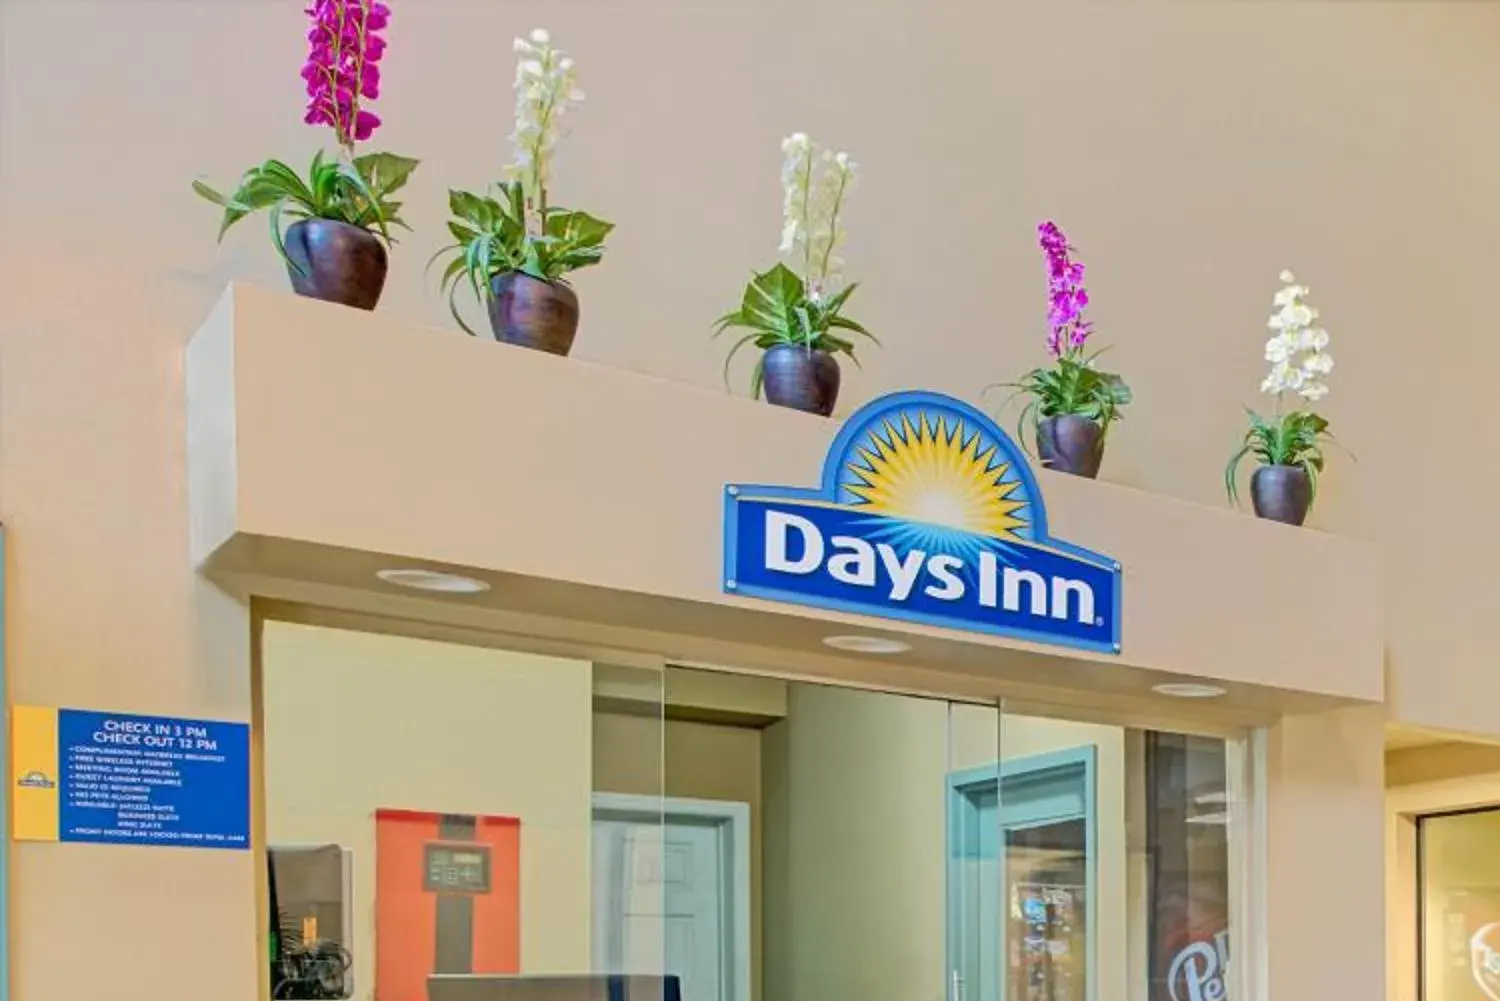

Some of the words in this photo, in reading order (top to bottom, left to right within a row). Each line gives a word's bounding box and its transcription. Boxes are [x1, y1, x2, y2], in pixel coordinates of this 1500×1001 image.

[764, 508, 966, 602] Days
[978, 550, 1096, 626] Inn
[104, 720, 151, 733] CHECK
[155, 724, 169, 735] IN
[186, 727, 206, 737] PM
[93, 732, 139, 745] CHECK
[143, 735, 174, 747] OUT
[179, 738, 191, 748] 12
[196, 739, 216, 750] PM
